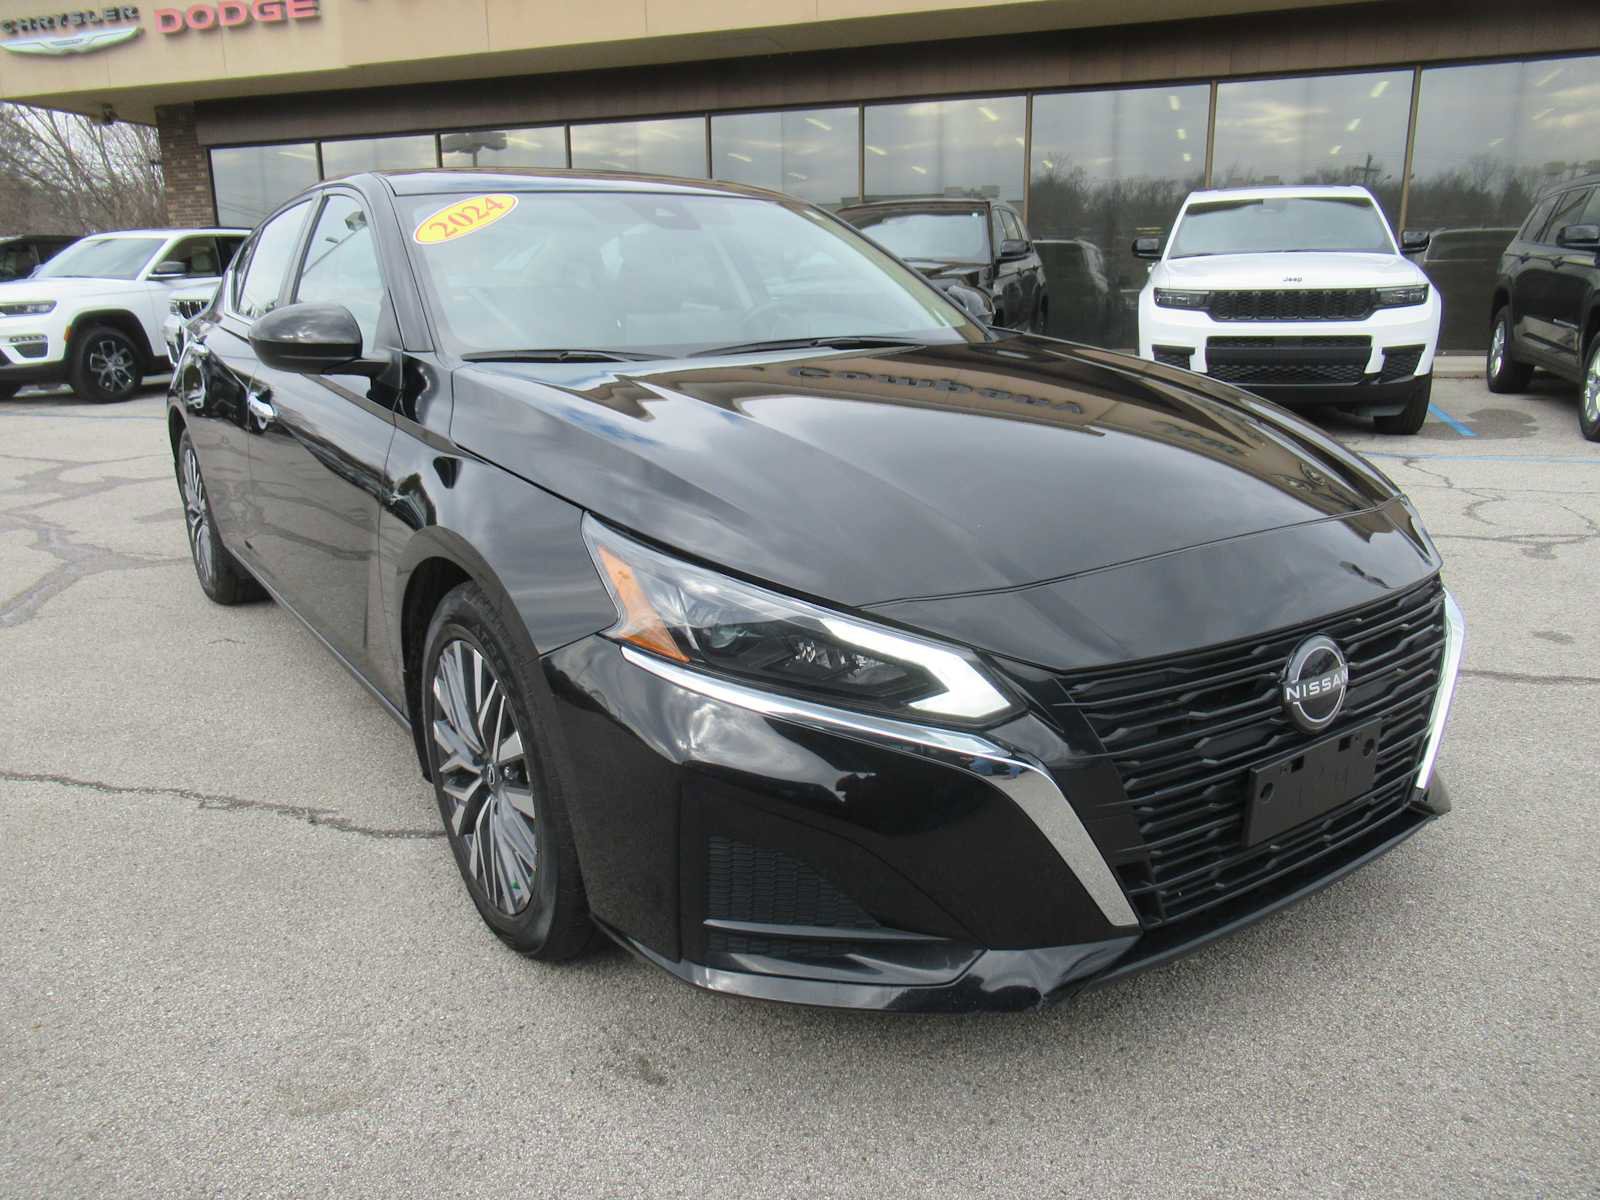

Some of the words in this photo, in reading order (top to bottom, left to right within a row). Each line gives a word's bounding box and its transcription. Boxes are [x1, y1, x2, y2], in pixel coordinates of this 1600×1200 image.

[0, 6, 141, 35] CHRYSLER
[154, 0, 320, 34] DODGE
[429, 197, 505, 238] 2024
